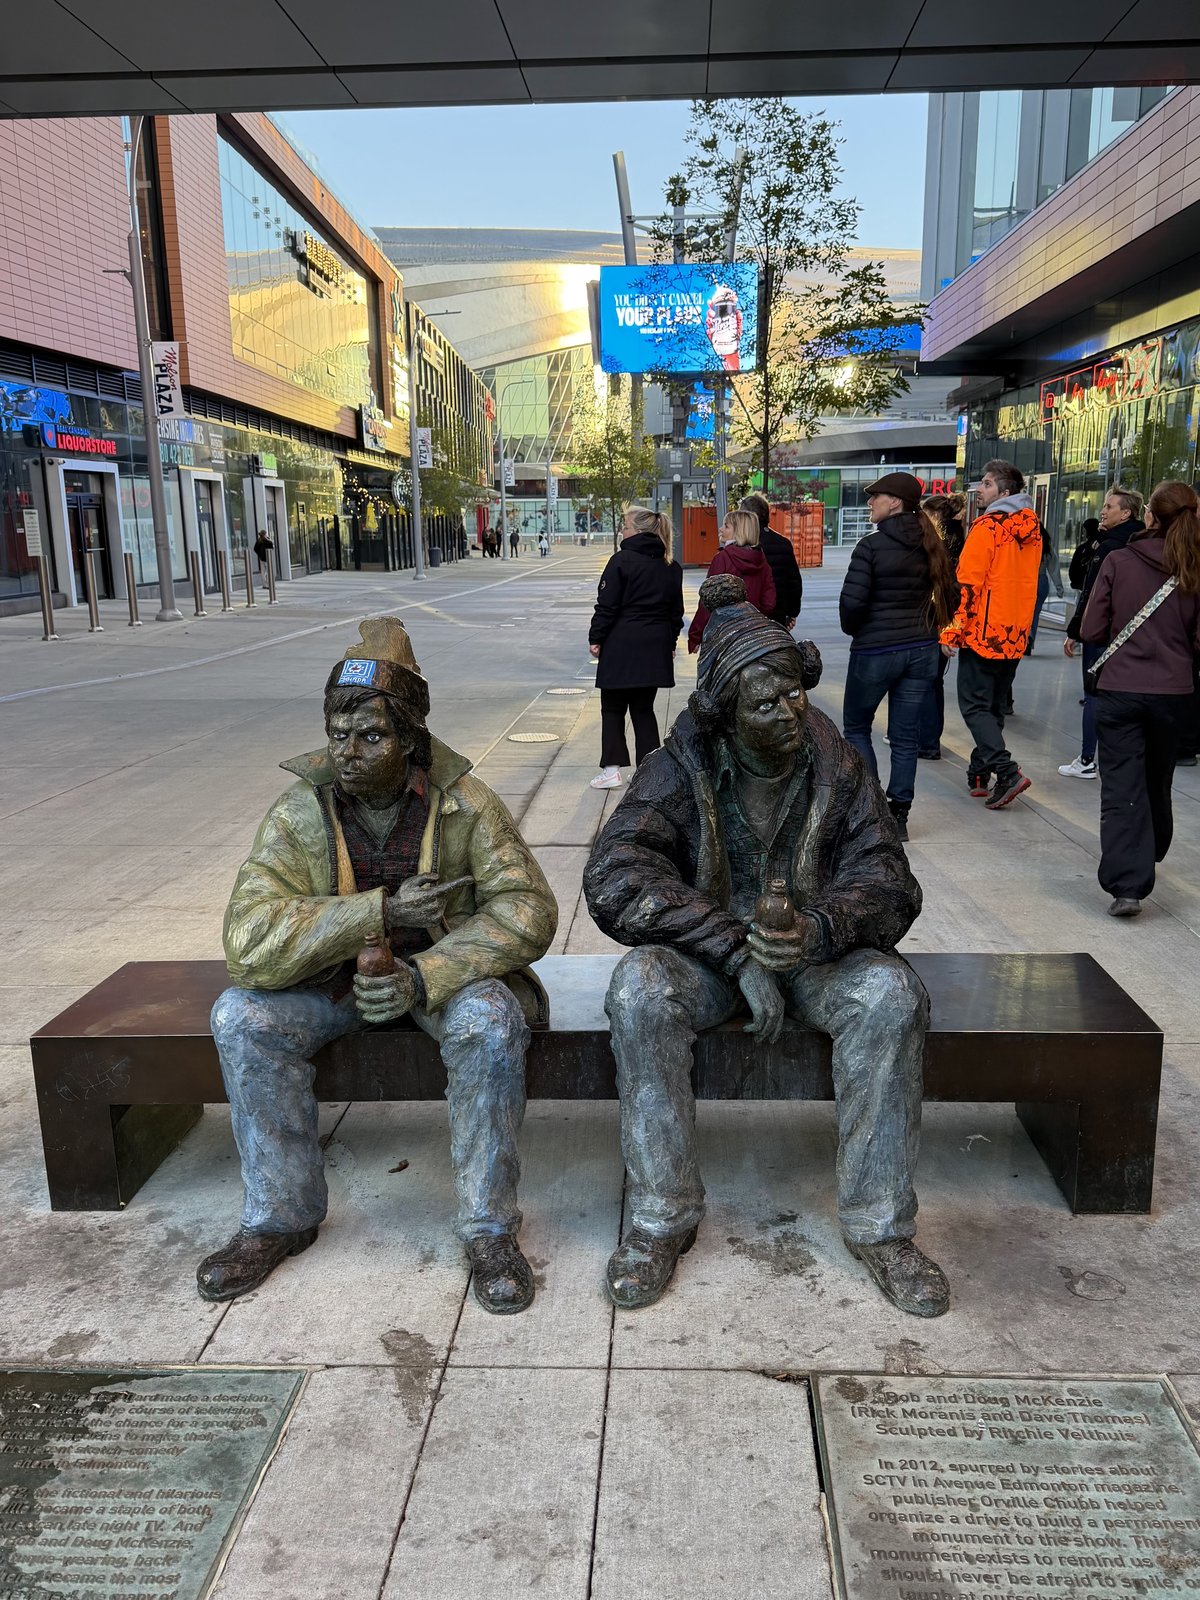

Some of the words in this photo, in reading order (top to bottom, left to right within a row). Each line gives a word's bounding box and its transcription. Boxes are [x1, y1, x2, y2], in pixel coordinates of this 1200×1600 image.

[616, 307, 654, 327] YOUR
[657, 306, 703, 326] PLANS
[162, 347, 178, 391] Molson
[155, 364, 174, 415] PLAZA
[419, 439, 428, 466] PLAZA
[161, 1394, 199, 1402] made
[212, 1393, 268, 1402] decision
[884, 1391, 920, 1405] Bob
[925, 1392, 958, 1405] and
[963, 1393, 1011, 1408] Doug
[1015, 1394, 1104, 1407] McKenzie
[128, 1405, 175, 1415] course
[177, 1406, 194, 1415] of
[195, 1405, 260, 1415] television
[851, 1405, 897, 1419] (Rick
[901, 1407, 976, 1421] Moranis
[981, 1409, 1014, 1422] and
[1019, 1410, 1065, 1423] Dave
[1066, 1411, 1151, 1427] Thomas)
[115, 1418, 163, 1428] chance
[167, 1418, 188, 1428] for
[189, 1420, 198, 1428] a
[124, 1431, 137, 1440] to
[876, 1423, 958, 1439] Sculpted
[962, 1426, 984, 1441] by
[989, 1427, 1054, 1440] Ritchie
[1056, 1428, 1137, 1442] Velthuis
[877, 1458, 895, 1470] In
[898, 1459, 944, 1473] 2012,
[948, 1462, 1016, 1475] spurred
[1020, 1463, 1040, 1476] by
[1044, 1464, 1105, 1476] stories
[1108, 1465, 1157, 1477] about
[61, 1488, 122, 1499] fictional
[124, 1489, 154, 1499] and
[156, 1488, 222, 1499] hilarious
[863, 1474, 907, 1486] SCTV
[911, 1476, 928, 1488] in
[933, 1476, 997, 1490] Avenue
[1000, 1479, 1090, 1493] Edmonton
[1094, 1482, 1186, 1497] magazine,
[96, 1506, 105, 1514] a
[109, 1505, 155, 1518] staple
[159, 1504, 177, 1515] of
[892, 1493, 974, 1508] publisher
[980, 1495, 1039, 1509] Orville
[1043, 1497, 1101, 1511] Chubb
[1104, 1498, 1168, 1513] helped
[67, 1520, 96, 1530] late
[100, 1520, 140, 1533] night
[172, 1520, 206, 1532] And
[868, 1511, 945, 1525] organize
[949, 1514, 960, 1525] a
[965, 1512, 1010, 1527] drive
[1014, 1514, 1033, 1527] to
[1035, 1515, 1083, 1528] build
[1087, 1518, 1099, 1528] a
[38, 1536, 70, 1547] and
[71, 1536, 113, 1550] Doug
[115, 1536, 194, 1550] McKenzie,
[912, 1531, 1012, 1545] monument
[1015, 1533, 1034, 1546] to
[1038, 1534, 1068, 1547] the
[1073, 1535, 1128, 1548] show.
[1129, 1535, 1170, 1549] This
[870, 1550, 966, 1563] monument
[975, 1551, 1031, 1565] exists
[1034, 1554, 1054, 1566] to
[1058, 1554, 1125, 1568] remind
[1130, 1557, 1153, 1568] us
[110, 1573, 136, 1584] the
[139, 1573, 181, 1584] most
[881, 1567, 945, 1582] should
[949, 1571, 1001, 1585] never
[1007, 1572, 1031, 1586] be
[1036, 1573, 1092, 1587] afraid
[1098, 1575, 1117, 1588] to
[958, 1591, 976, 1600] at
